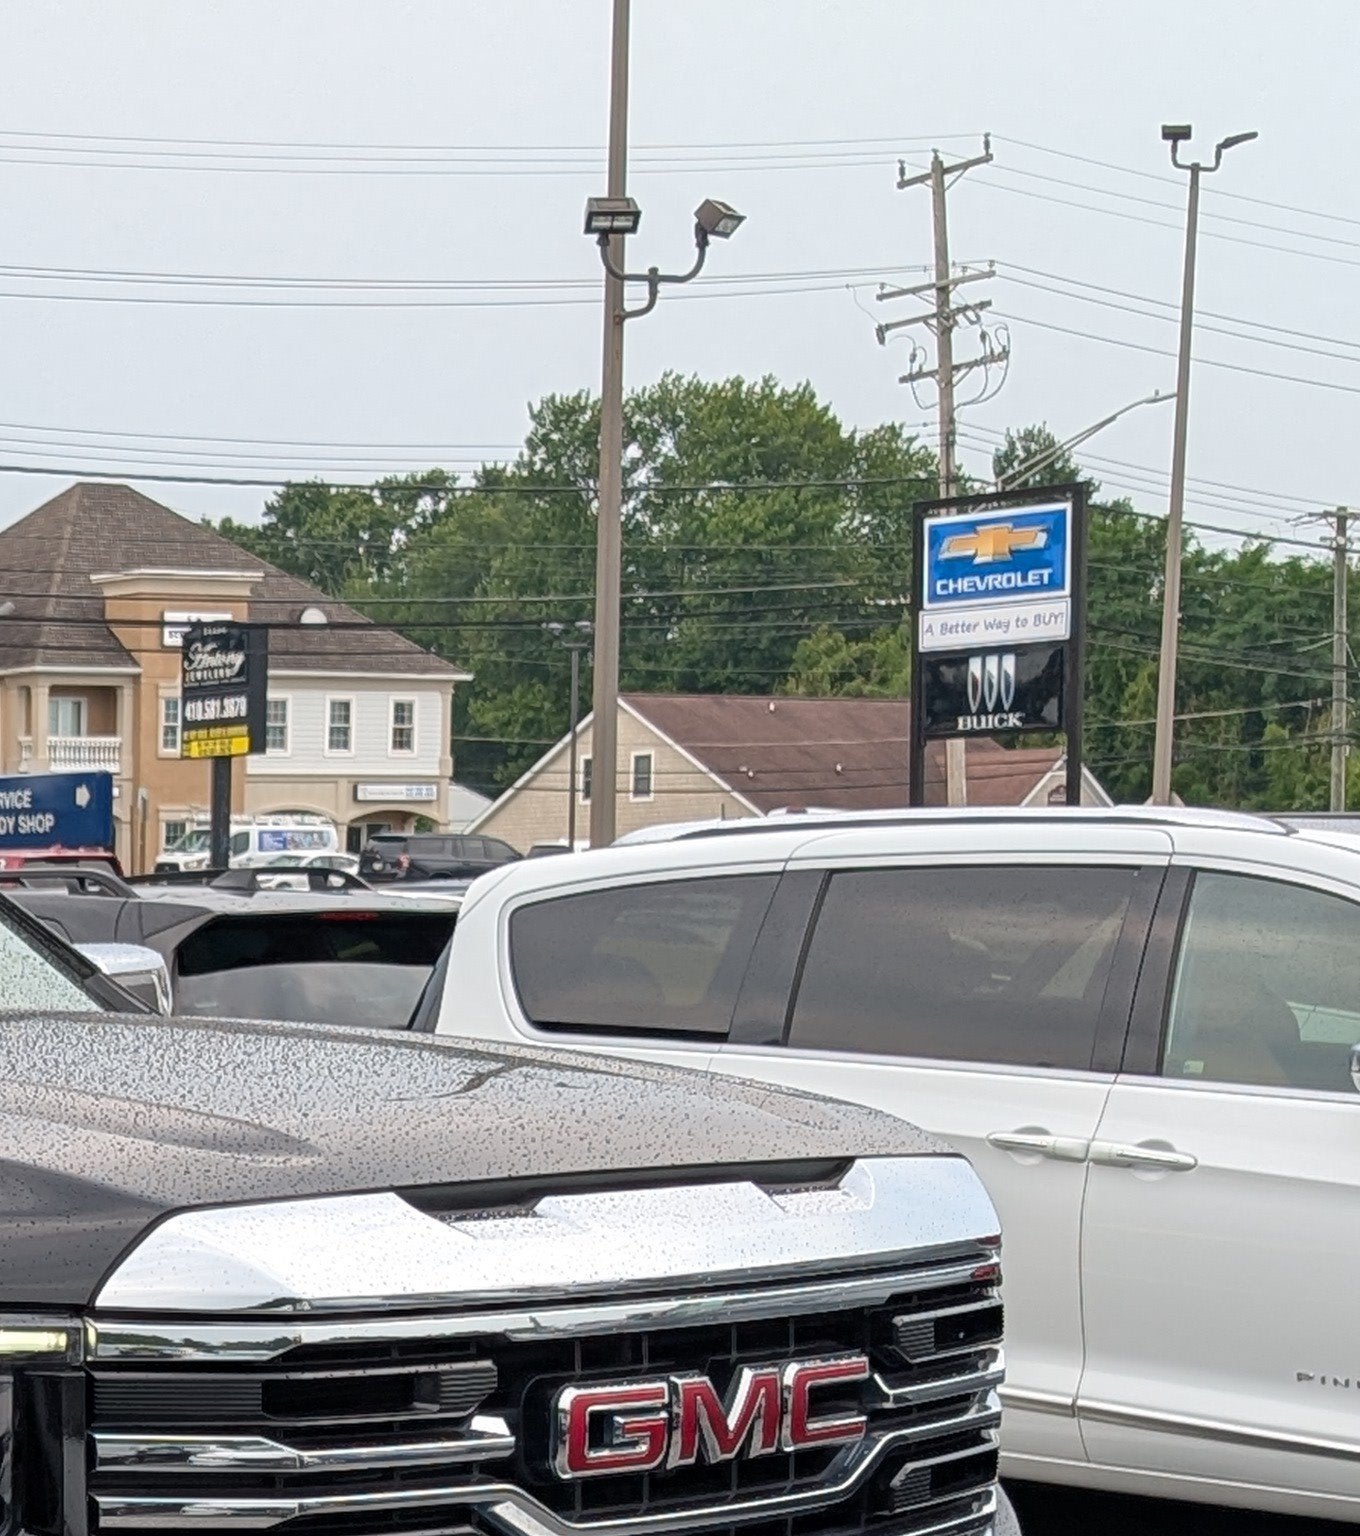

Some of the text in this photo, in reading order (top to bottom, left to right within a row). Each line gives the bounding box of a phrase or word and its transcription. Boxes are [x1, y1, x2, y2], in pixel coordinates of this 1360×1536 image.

[936, 568, 1053, 595] CHEVROLET
[925, 623, 934, 636] A
[940, 621, 979, 635] Better
[984, 618, 1010, 634] Way
[1016, 616, 1028, 628] to
[957, 712, 1023, 730] BUICK
[18, 812, 55, 834] SHOP
[555, 1356, 870, 1479] GMC
